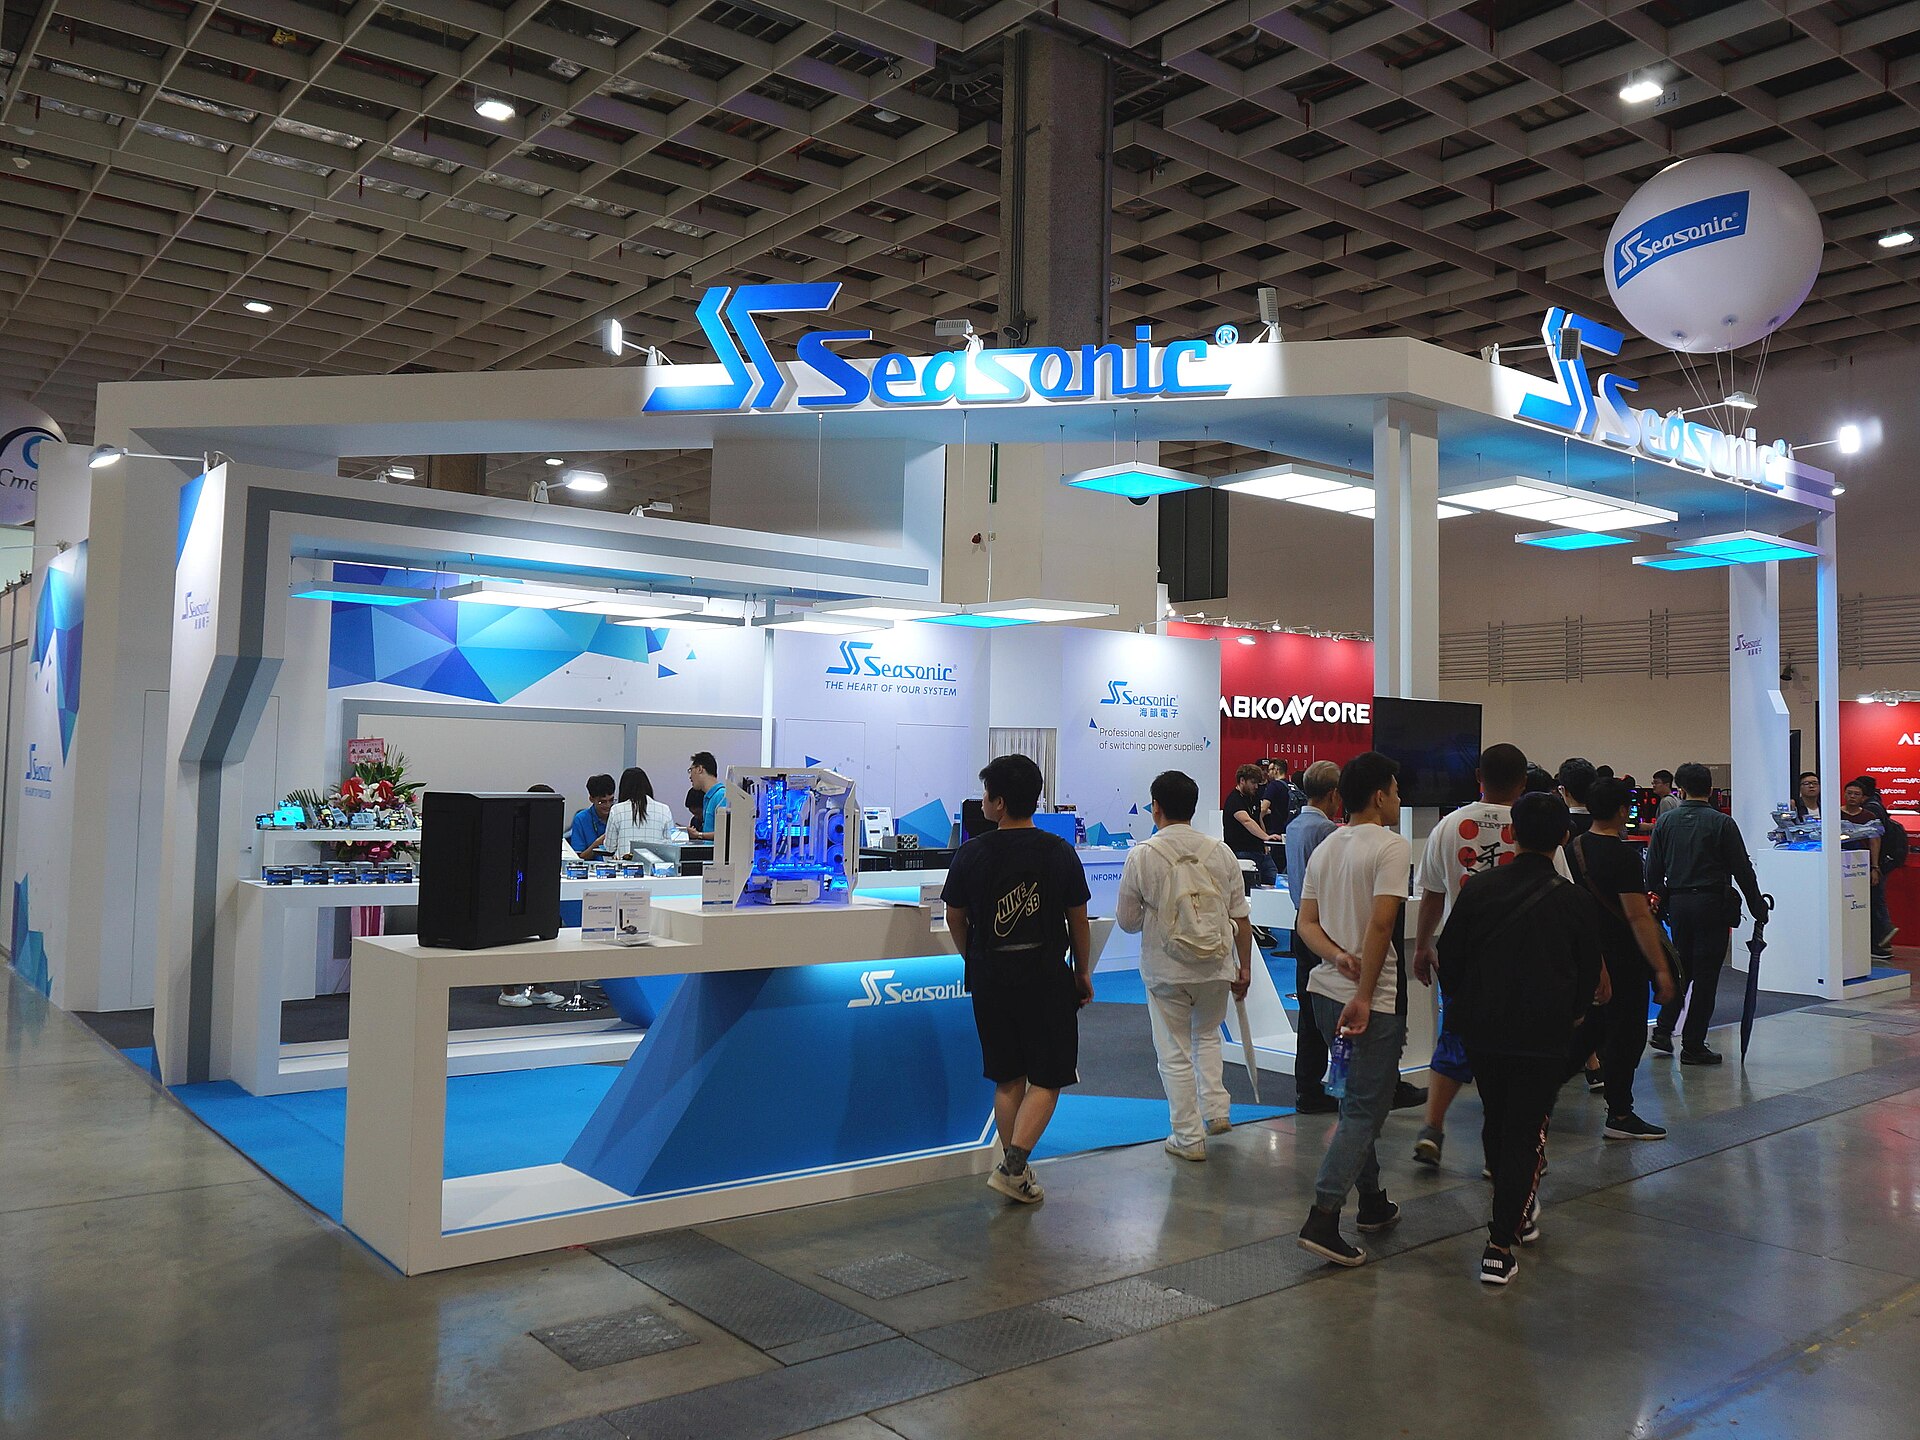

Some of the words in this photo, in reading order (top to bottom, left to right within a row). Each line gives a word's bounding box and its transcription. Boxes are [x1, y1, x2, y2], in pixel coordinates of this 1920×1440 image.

[1637, 215, 1740, 263] Seasonic
[797, 325, 1233, 406] Seasonic
[1598, 373, 1785, 490] Seasonic
[863, 656, 957, 682] Seasonic
[825, 680, 844, 690] THE
[847, 682, 878, 692] HEART
[881, 684, 893, 693] OF
[896, 685, 920, 694] YOUR
[923, 687, 957, 696] SYSTEM
[1122, 690, 1179, 707] Seasonic
[1099, 728, 1146, 738] Professional
[1148, 729, 1180, 740] designer
[1099, 741, 1107, 749] of
[1110, 741, 1146, 752] switching
[1148, 742, 1172, 752] power
[1174, 742, 1204, 752] supplies
[1274, 743, 1309, 754] DESIGN
[998, 881, 1028, 920] NIKE
[1026, 893, 1040, 917] SB
[1483, 1258, 1503, 1269] PUMA
